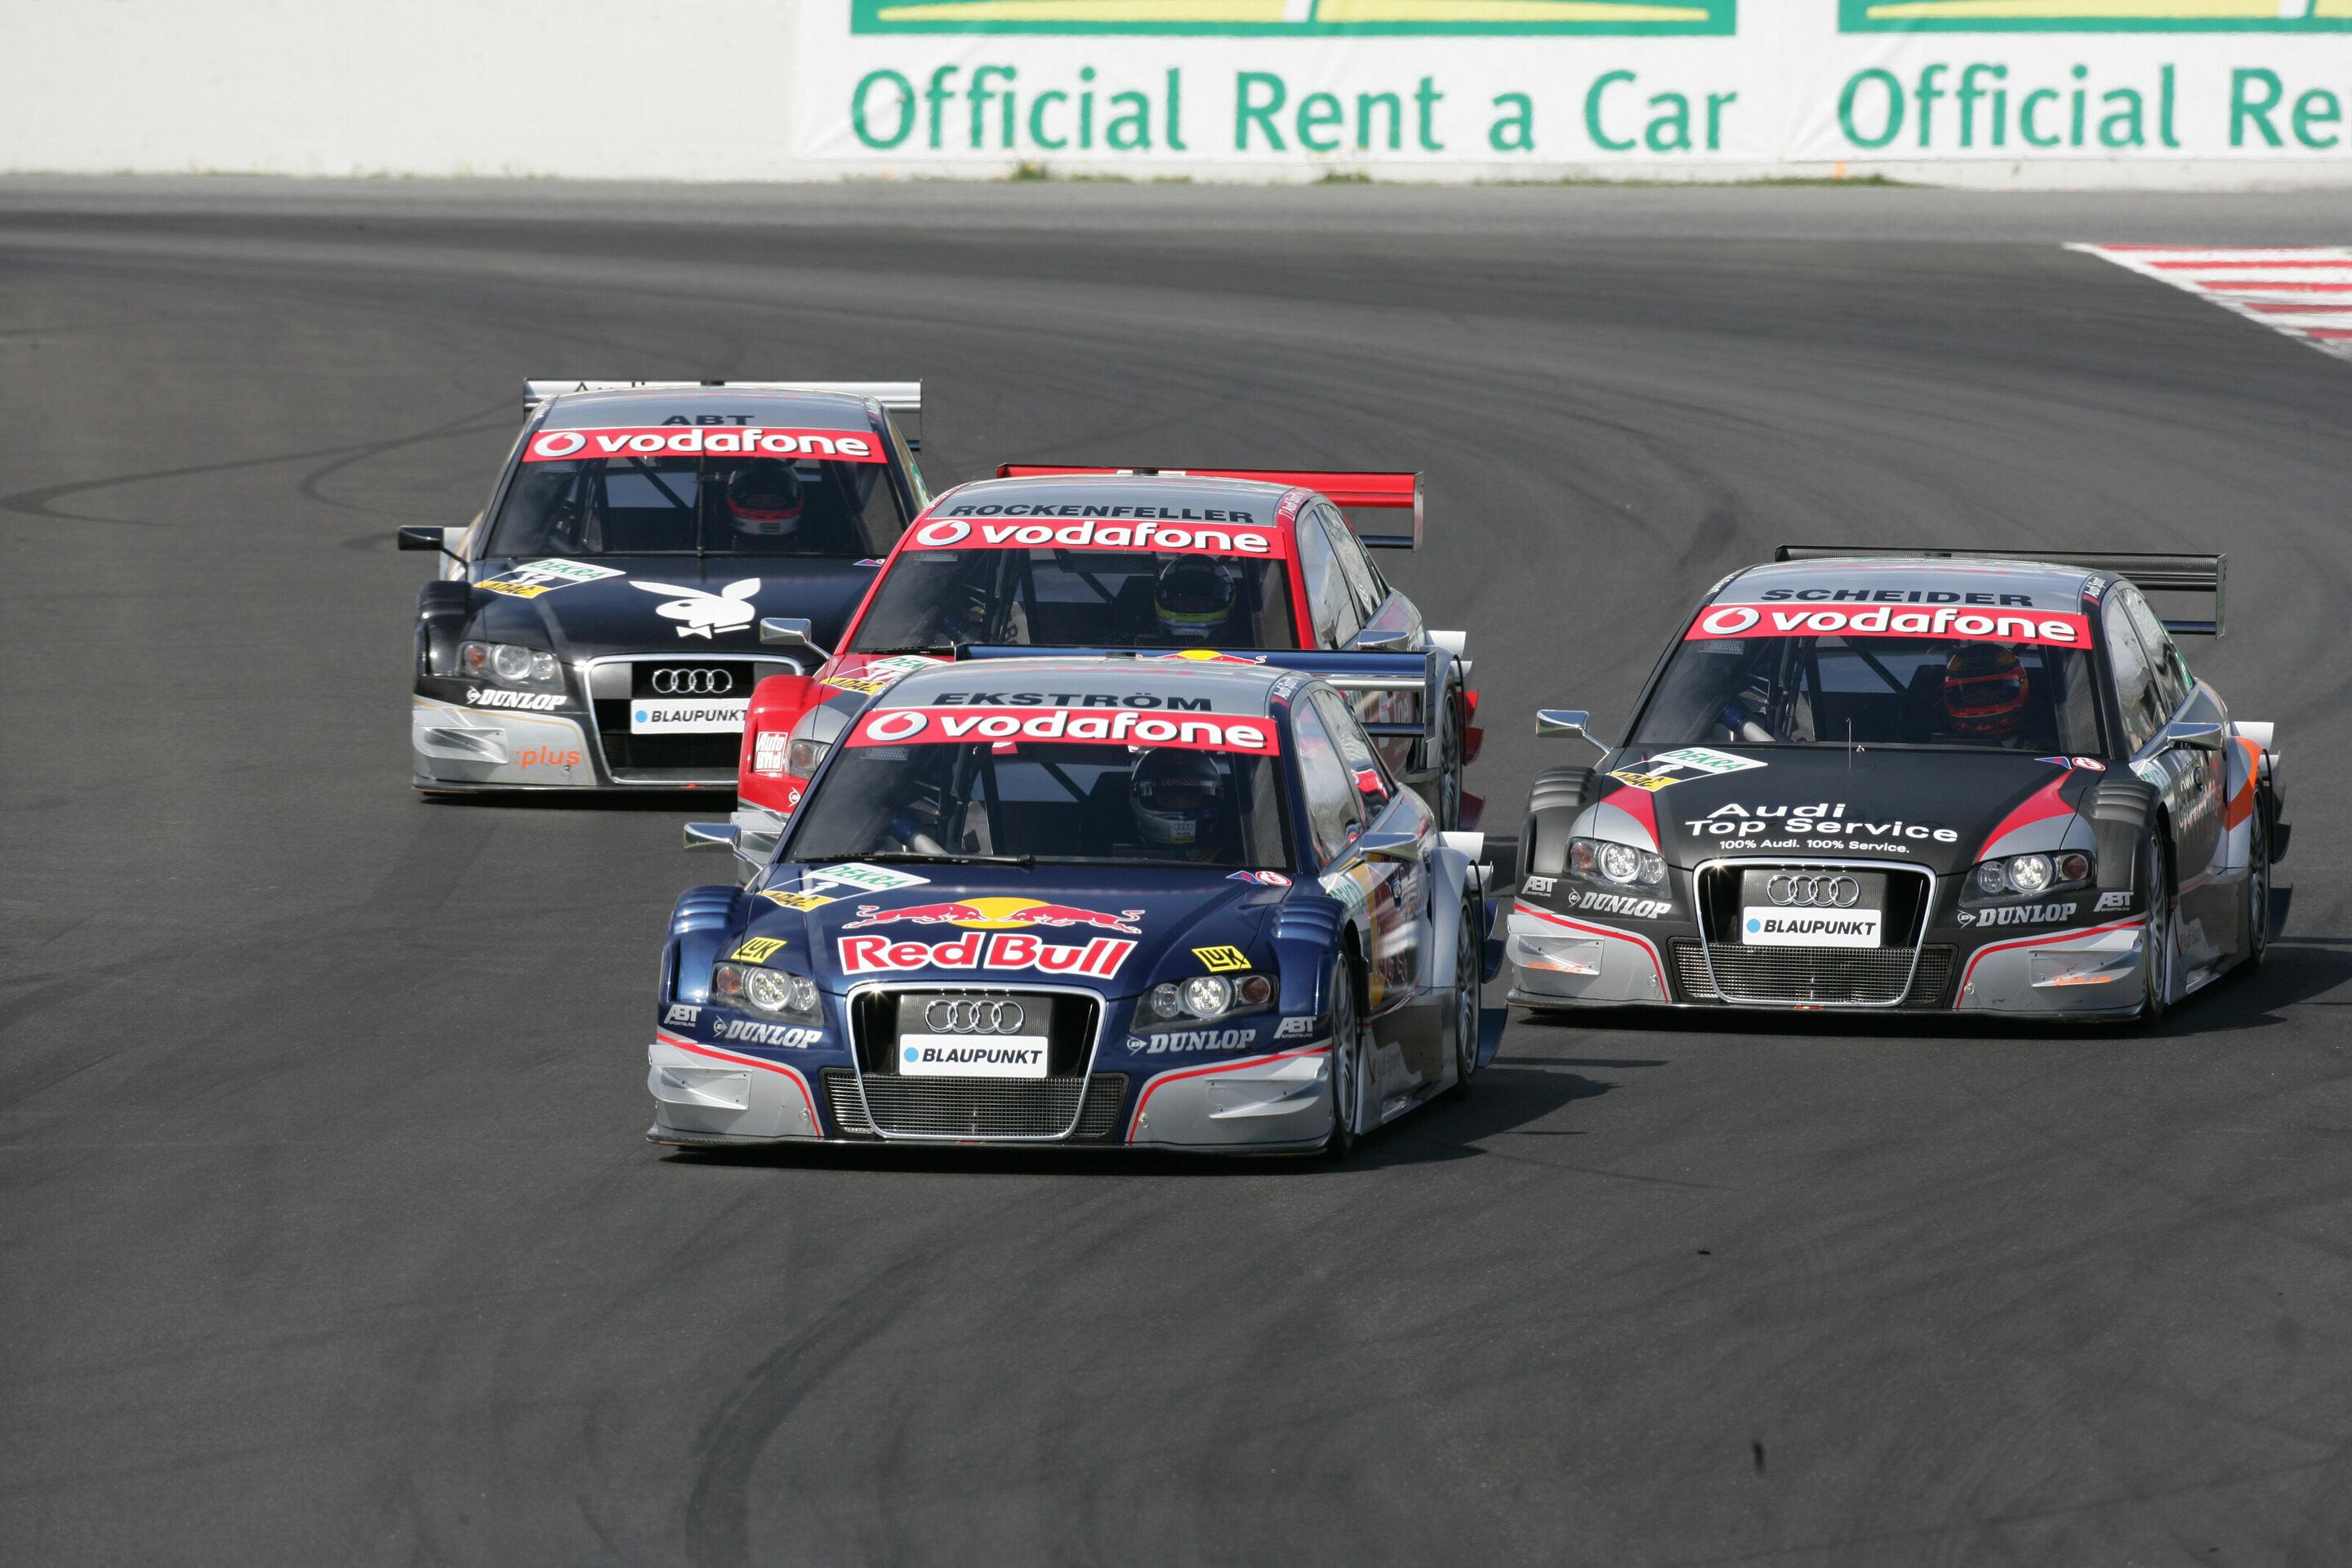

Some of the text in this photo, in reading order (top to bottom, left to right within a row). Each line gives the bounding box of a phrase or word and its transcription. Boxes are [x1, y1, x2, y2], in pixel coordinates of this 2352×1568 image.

[851, 65, 1739, 153] Official Rent a Car
[1838, 63, 2181, 150] Official
[661, 415, 755, 426] ABT
[595, 429, 871, 457] vodafone
[948, 504, 1255, 524] ROCKENFELLER
[982, 520, 1271, 554] vodafone
[529, 561, 606, 579] DEKRA
[1761, 588, 2034, 608] SCHEIDER
[1771, 607, 2080, 642] vodafone
[479, 689, 567, 710] DUNLOP
[932, 691, 1213, 711] EKSTRÖM
[651, 709, 746, 723] BLAUPUNKT
[940, 710, 1267, 749] vodafone
[1661, 750, 1748, 771] DEKRA
[1706, 803, 1846, 818] Audi
[1685, 817, 1958, 843] Top Service
[1719, 839, 1910, 853] 100% Audi. 100% Service.
[817, 866, 910, 889] DEKRA
[1521, 876, 1558, 894] ABT
[1579, 891, 1673, 920] DUNLOP
[2092, 891, 2134, 912] ABT
[1976, 902, 2078, 928] DUNLOP
[1763, 920, 1877, 936] BLAUPUNKT
[839, 933, 1136, 978] Red Bull
[663, 1004, 702, 1024] ABT
[724, 1019, 823, 1049] DUNLOP
[1273, 1017, 1317, 1039] ABT
[1146, 1029, 1256, 1054] DUNLOP
[922, 1047, 1043, 1065] BLAUPUNKT
